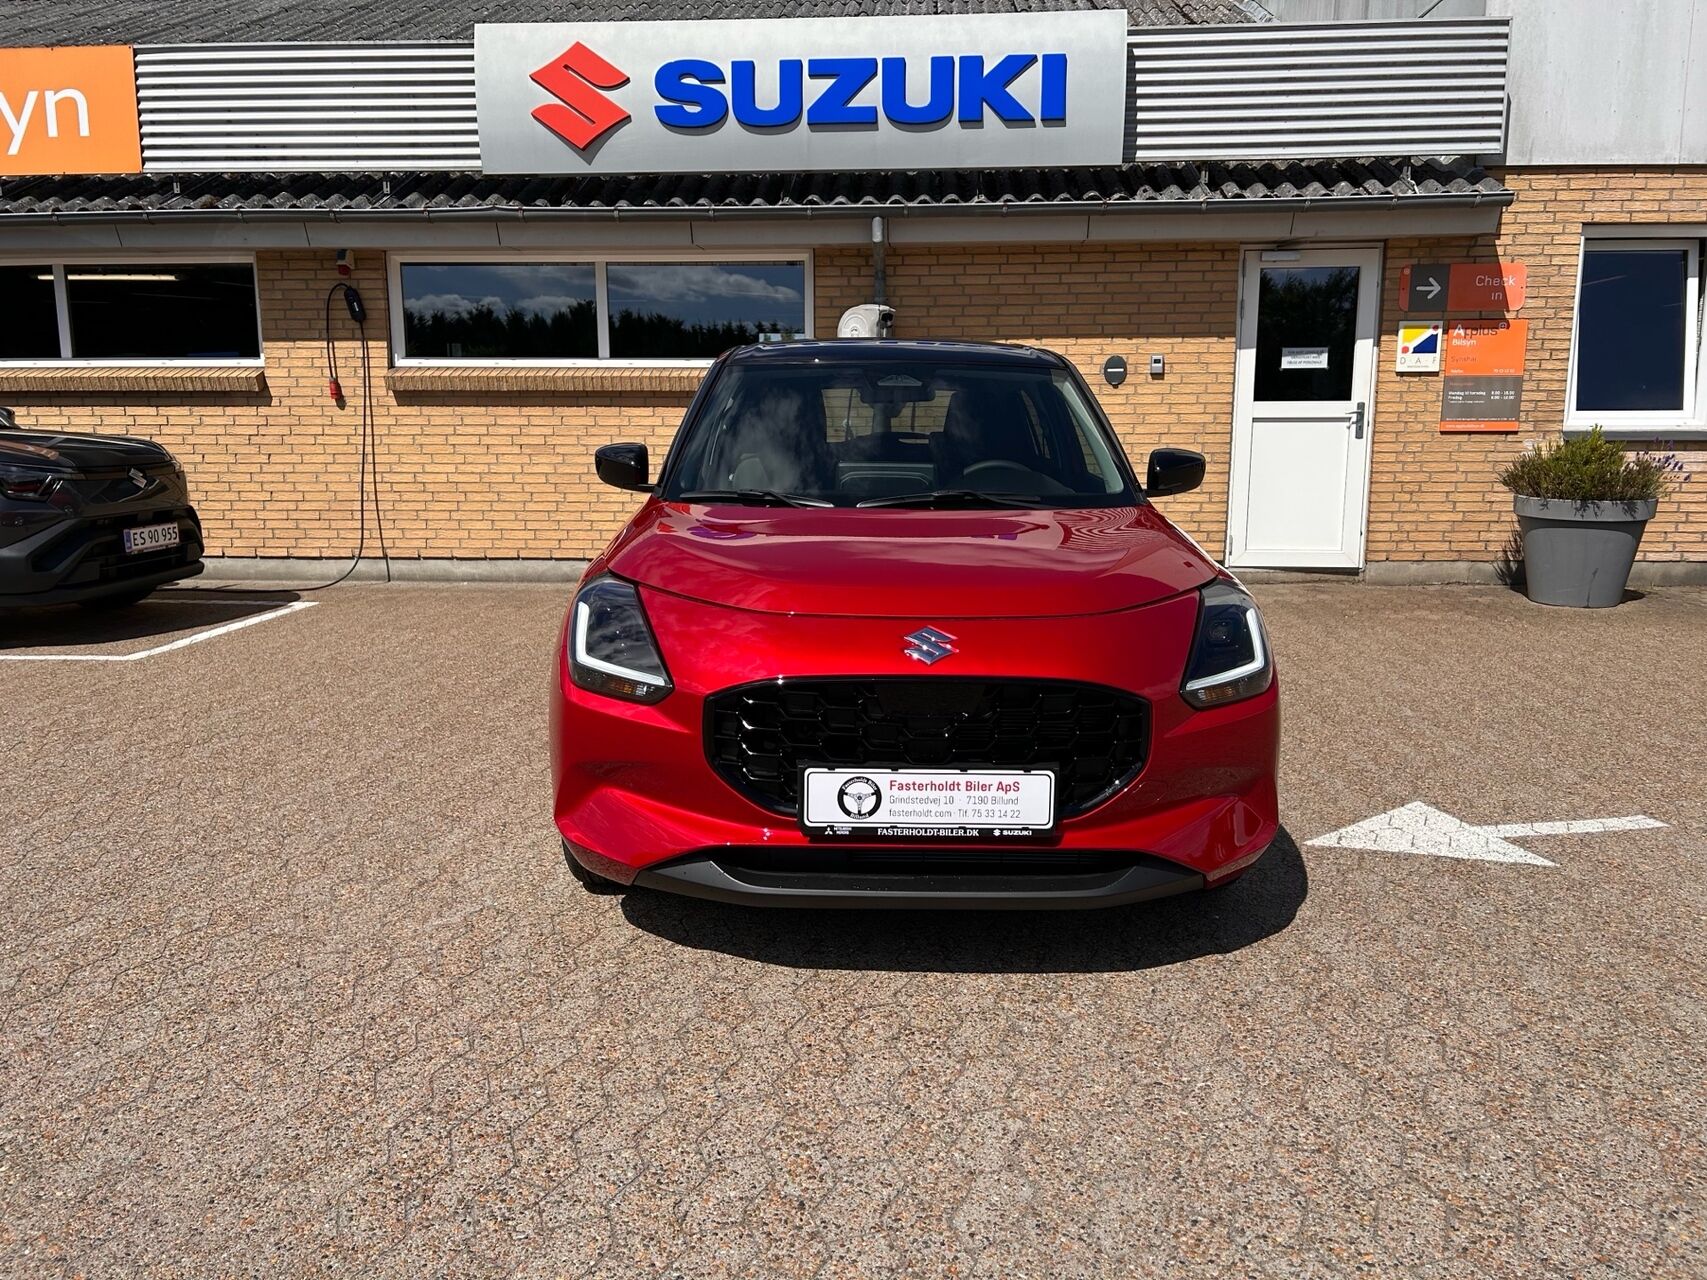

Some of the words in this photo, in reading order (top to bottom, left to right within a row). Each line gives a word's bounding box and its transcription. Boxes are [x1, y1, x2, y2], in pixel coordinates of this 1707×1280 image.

[654, 53, 1067, 128] SUZUKI
[1474, 275, 1516, 287] Check
[1491, 291, 1503, 301] in
[1452, 338, 1477, 348] Bilsyn
[132, 531, 146, 547] ES
[148, 529, 160, 544] 90
[161, 526, 178, 541] 955
[889, 780, 961, 791] Fasterholdt
[965, 780, 993, 792] Biler
[996, 781, 1020, 795] ApS
[889, 795, 941, 806] Grindstedvej
[943, 795, 954, 805] 10
[966, 795, 989, 805] 7190
[991, 796, 1019, 805] Billund
[972, 809, 982, 818] 75
[985, 809, 995, 818] 33
[998, 810, 1008, 818] 14
[1010, 810, 1021, 818] 22
[877, 828, 979, 836] FASTERHOLDT-BILER.DK
